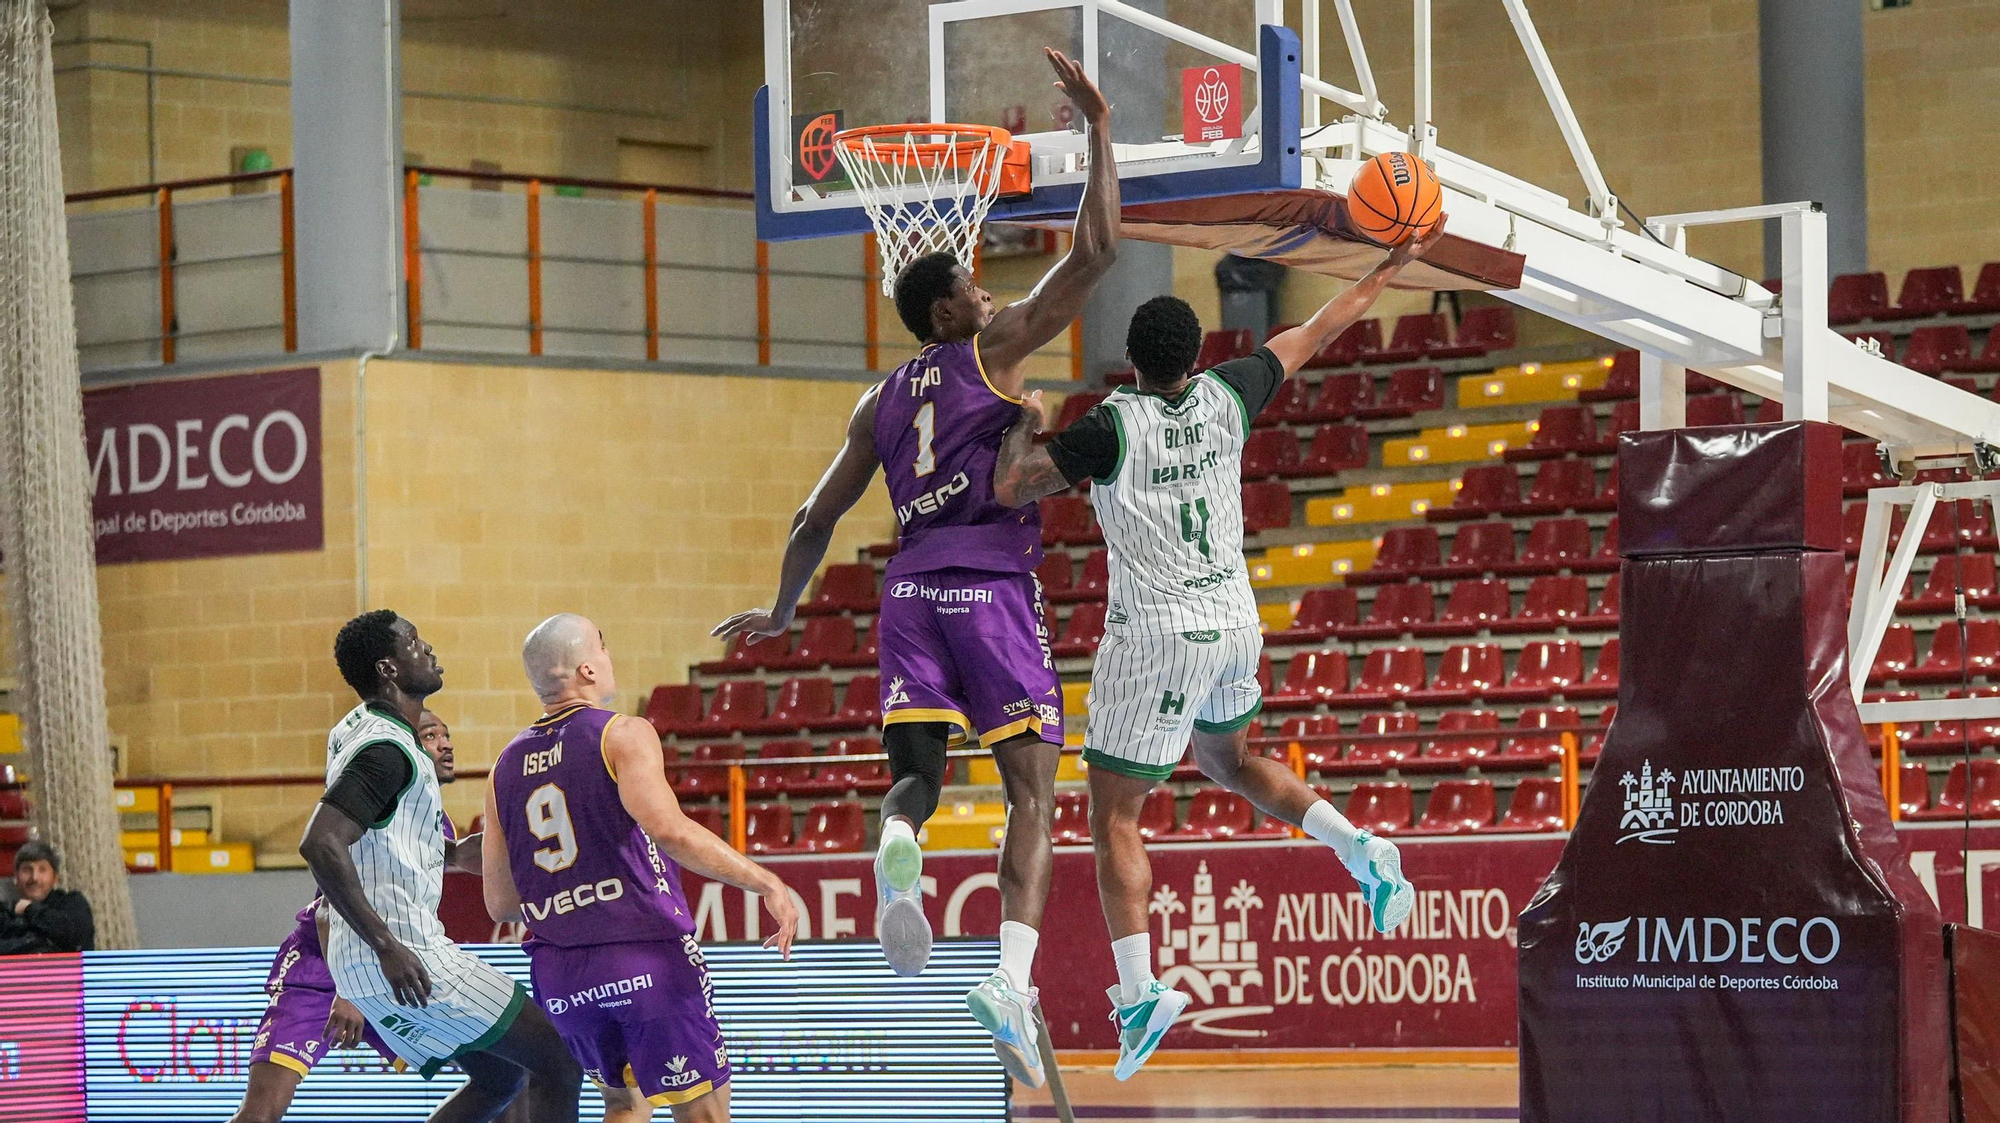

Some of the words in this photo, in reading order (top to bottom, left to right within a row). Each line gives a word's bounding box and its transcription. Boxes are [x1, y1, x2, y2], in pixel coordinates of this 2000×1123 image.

[1202, 130, 1224, 140] FEB
[913, 401, 936, 478] 1
[1164, 422, 1207, 449] BLAC
[89, 410, 308, 497] MDECO
[124, 512, 146, 532] de
[151, 508, 228, 535] Deportes
[231, 501, 306, 525] Córdoba
[1180, 497, 1213, 563] 4
[921, 585, 992, 603] HYUNDAI
[1190, 630, 1215, 641] Ford
[1040, 704, 1060, 721] CBC
[1681, 766, 1804, 794] AYUNTAMIENTO
[525, 782, 578, 873] 9
[1681, 803, 1701, 826] DE
[520, 878, 623, 922] IVECO
[1637, 917, 1841, 964] IMDECO
[570, 973, 653, 1007] HYUNDAI
[1273, 956, 1314, 1005] DE
[1320, 947, 1477, 1005] CÓRDOBA
[1576, 974, 1629, 988] Instituto
[1632, 974, 1696, 991] Municipal
[1699, 974, 1716, 988] de
[1720, 975, 1780, 991] Deportes
[1782, 973, 1839, 989] Córdoba
[661, 1069, 701, 1087] CRZA
